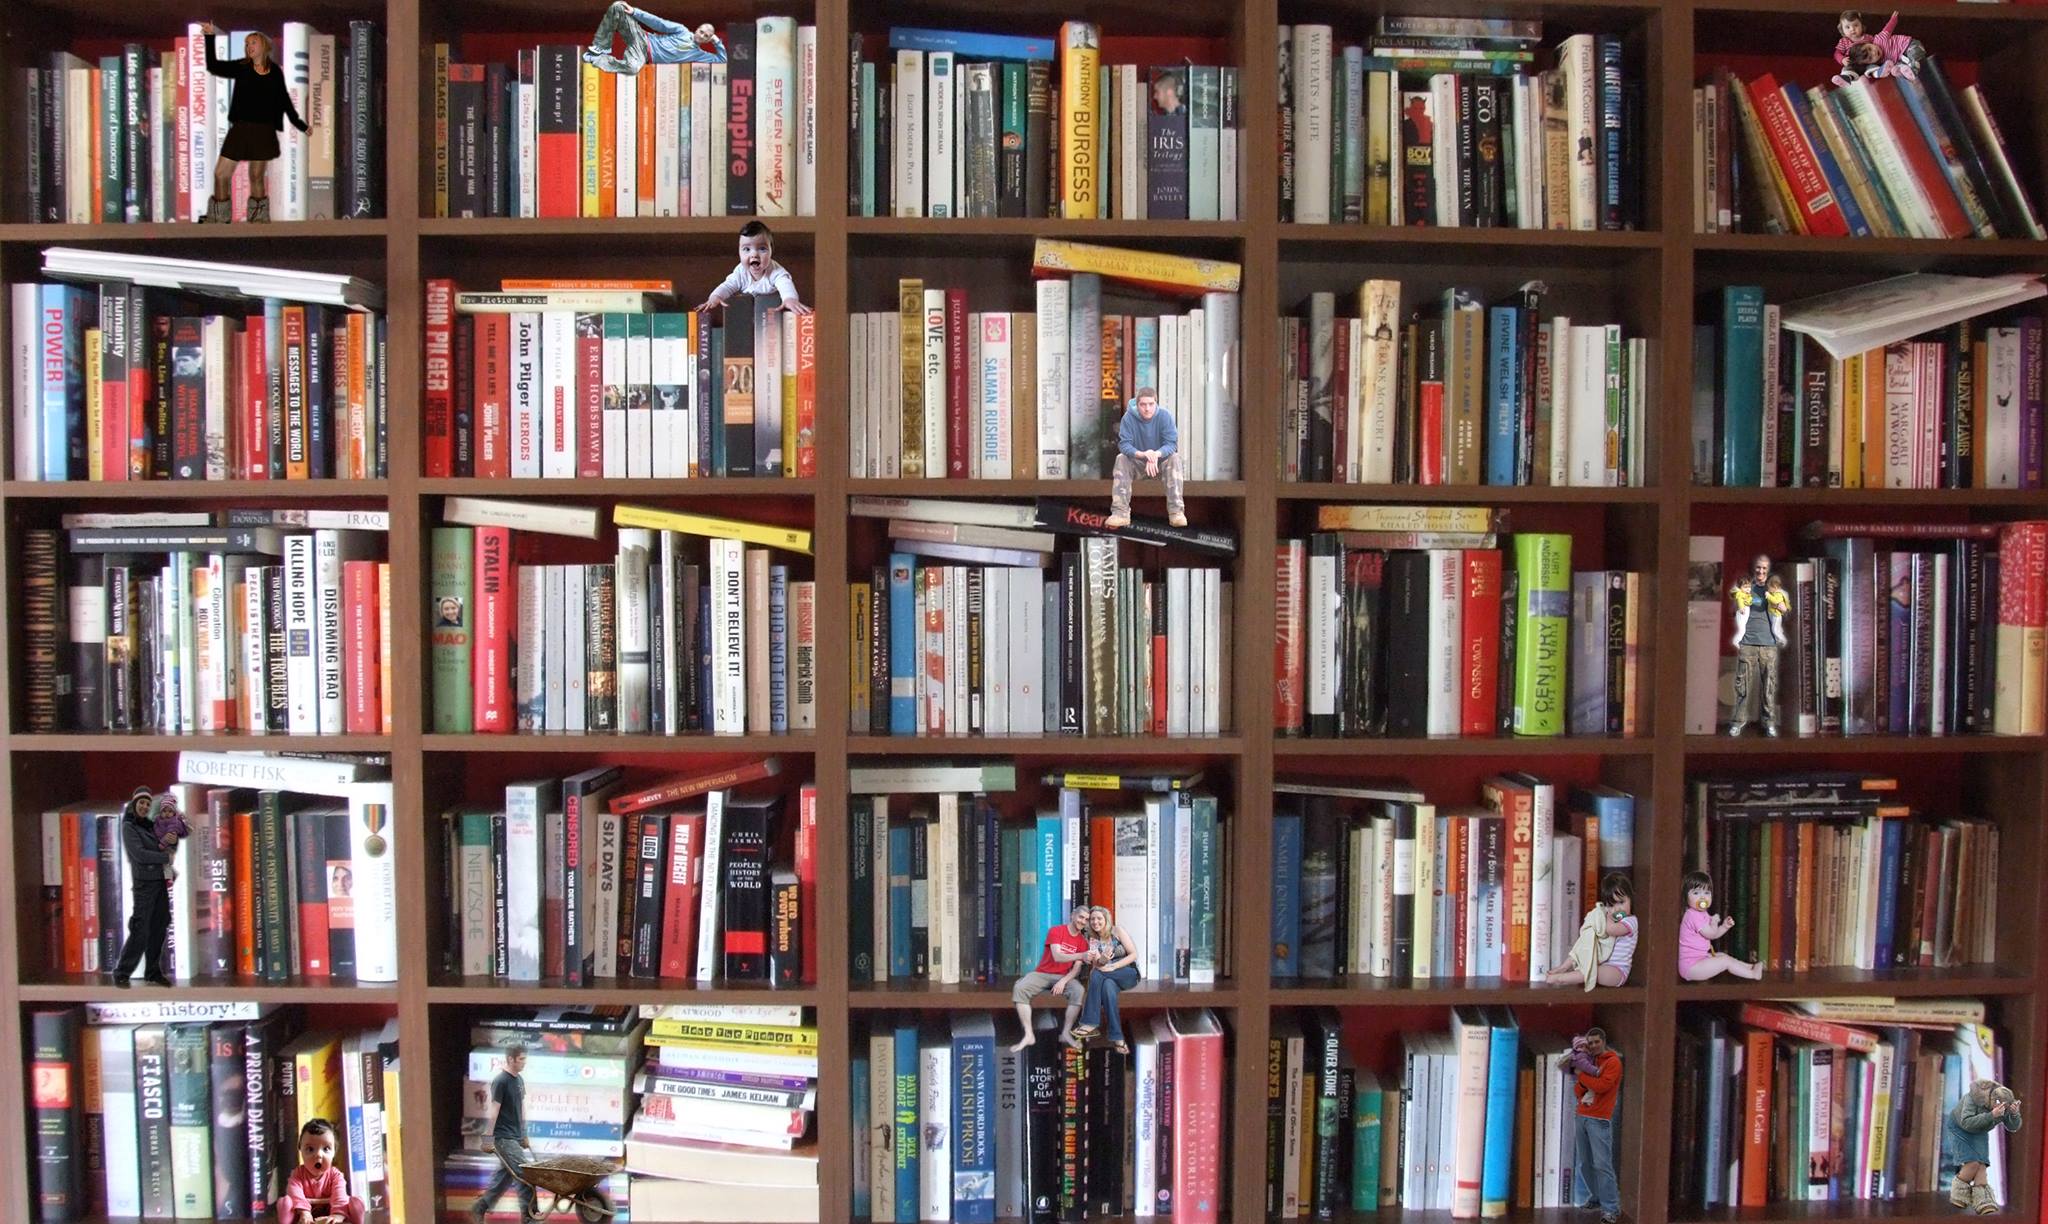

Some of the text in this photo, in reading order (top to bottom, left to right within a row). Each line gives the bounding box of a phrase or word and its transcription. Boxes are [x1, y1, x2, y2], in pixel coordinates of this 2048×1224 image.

[193, 34, 206, 190] NOAM CHOMSKY FAILED STATES
[313, 44, 330, 128] FATEFUL TRIANGLE
[553, 54, 563, 124] Mein Kampf
[774, 79, 782, 140] STEVEN
[1478, 85, 1490, 123] ECO
[1582, 44, 1592, 124] Frank McCourt
[1605, 41, 1621, 128] THE INFORMER
[108, 70, 119, 180] Patterns of Democracy
[585, 111, 596, 159] NOREENA
[728, 79, 752, 176] Empire
[1073, 54, 1090, 203] ANTHONY BURGESS
[1153, 150, 1184, 161] Trilogy
[1161, 128, 1176, 137] The
[1462, 86, 1471, 209] RODDY DOYLE THE VAN
[1762, 96, 1812, 194] CATHOLIC CHURCH
[1768, 92, 1822, 193] CATECHISM OF THE
[585, 160, 596, 196] HERTZ
[602, 148, 614, 189] SATAN
[46, 309, 64, 382] POWER
[113, 296, 125, 357] humanity
[427, 282, 449, 391] JOHN PILGER
[801, 315, 813, 370] RUSSIA
[926, 308, 943, 379] LOVE, etc.
[334, 335, 346, 388] HERESIES
[518, 321, 531, 461] John Pilger HEROES
[1498, 314, 1510, 435] IRVINE WELSH FILTH
[289, 347, 302, 460] MESSAGES TO THE WORLD
[590, 346, 600, 463] ERIC HOBSBAWM
[985, 358, 998, 461] SALMAN RUSHDIE
[1809, 371, 1826, 447] Historian
[1890, 402, 1909, 467] MARGARET ATWOOD
[346, 513, 382, 528] IRAQ
[291, 539, 305, 623] KILLING HOPE
[484, 535, 500, 593] STALIN
[1089, 540, 1114, 599] JAMES JOYCE
[1541, 539, 1559, 588] KURT ANDERSEN
[728, 571, 740, 677] DON'T BELIEVE IT!
[1609, 604, 1623, 650] CASH
[1826, 573, 1837, 620] Burgess
[324, 589, 339, 700] DISARMING IRAQ
[432, 632, 468, 646] MAO
[770, 574, 785, 723] WE DID NOTHING
[797, 585, 813, 704] THE RUSSIANS Hedrick Smith
[1471, 636, 1483, 699] TOWNSEND
[270, 631, 288, 709] THE TROUBLES
[186, 758, 286, 782] ROBERT FISK
[567, 796, 579, 867] CENSORED
[601, 821, 615, 892] SIX DAYS
[643, 837, 657, 858] LOGO
[672, 824, 690, 885] WEB of DECEIT
[1044, 833, 1054, 876] ENGLISH
[1512, 795, 1531, 925] DBC PIERRE
[212, 859, 227, 892] said
[468, 853, 486, 939] NIETZSCHE
[788, 886, 798, 919] we are
[777, 891, 790, 952] everywhere
[157, 1002, 237, 1018] history!
[143, 1055, 164, 1118] FIASCO
[246, 1052, 263, 1103] PRISON
[281, 1061, 294, 1095] PUTIN'S
[662, 1084, 779, 1104] THE GOOD TIMES JAMES KELMAN
[896, 1075, 906, 1106] LODGE
[906, 1075, 916, 1106] DAVID
[1001, 1057, 1015, 1110] MOVIES
[1030, 1074, 1055, 1082] STORY
[1034, 1066, 1052, 1074] THE
[1034, 1090, 1054, 1098] FILM
[1037, 1082, 1050, 1090] OF
[1324, 1039, 1338, 1096] OLIVER STONE
[1339, 1075, 1352, 1119] sleepers
[1754, 1041, 1767, 1144] Poems of Paul Celan
[248, 1109, 265, 1152] DIARY
[961, 1054, 975, 1167] ENGLISH PROSE
[1064, 1047, 1077, 1195] EASY RIDERS, RAGING BULLS
[896, 1127, 917, 1169] DEAF SENTENCE
[1187, 1102, 1197, 1196] LOVE STORIES
